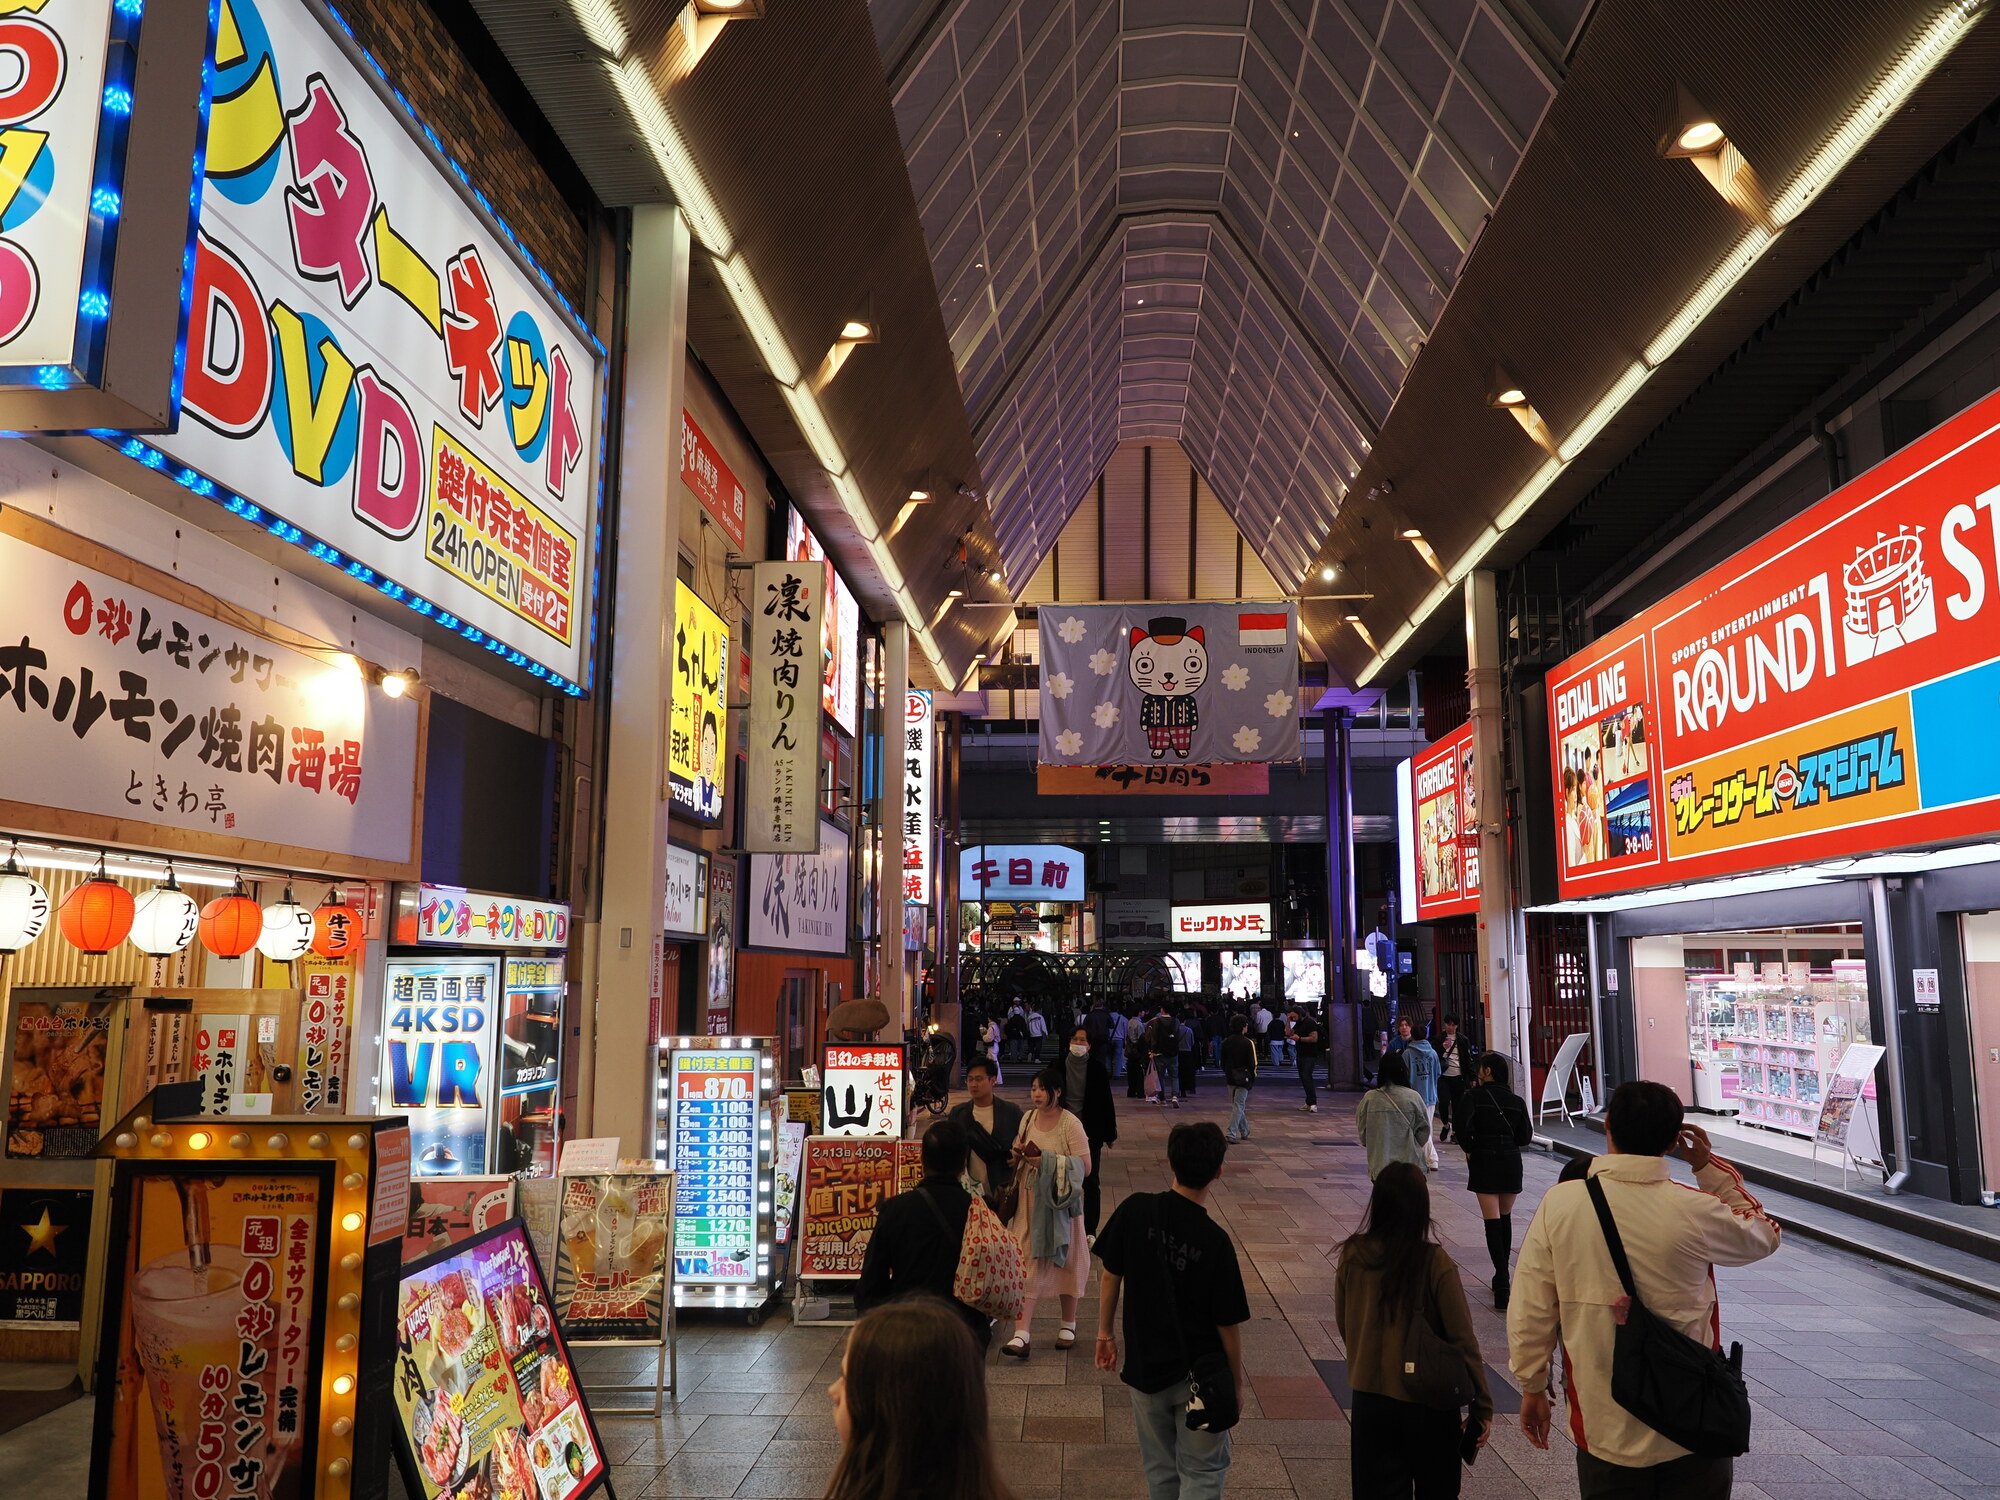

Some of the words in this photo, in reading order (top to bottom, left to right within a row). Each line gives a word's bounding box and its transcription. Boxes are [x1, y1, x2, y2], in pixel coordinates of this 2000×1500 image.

[183, 222, 426, 541] DVD
[437, 443, 572, 593] 鍵付完全個室
[1671, 636, 1709, 665] SPORTS
[1712, 584, 1806, 645] ENTERTAINMENT
[1672, 572, 1836, 737] ROUND1
[770, 628, 803, 751] 焼肉りん
[1557, 660, 1627, 732] BOWLING
[0, 635, 362, 805] ホルモン焼肉酒場
[1417, 756, 1455, 800] KARAOKE
[1799, 734, 1903, 804] スタジアム
[124, 769, 227, 824] ときわ亭
[785, 759, 794, 815] YAKINIKU
[785, 823, 793, 843] RIN
[971, 858, 1070, 889] 千日前
[22, 882, 49, 938] ハラミ
[176, 900, 198, 947] カルビ
[1180, 915, 1262, 932] ビックカメラ
[292, 912, 312, 951] ロース
[392, 974, 487, 1004] 超高画質
[391, 1005, 485, 1034] 4KSD
[327, 975, 348, 1105] 全卓サワータワー完備
[303, 1000, 327, 1114] 0秒レモン
[837, 1051, 900, 1067] 幻の手羽先
[387, 1039, 483, 1109] VR
[704, 1077, 752, 1099] 870円
[711, 1101, 752, 1114] 1,100円
[874, 1072, 896, 1130] 世界の
[707, 1131, 752, 1143] 3,400円
[708, 1116, 752, 1129] 2,100円
[707, 1145, 752, 1158] 4,250円
[707, 1160, 752, 1172] 2,540円
[812, 1147, 852, 1158] 2月13日
[707, 1175, 751, 1187] 2,240円
[810, 1160, 894, 1183] コース料金
[706, 1205, 750, 1217] 3,400円
[707, 1190, 751, 1202] 2,540円
[248, 1221, 275, 1251] 元祖
[406, 1216, 470, 1238] 日本一
[708, 1219, 750, 1232] 1,270円
[675, 1257, 709, 1274] VR
[575, 1271, 643, 1291] スーパー
[277, 1218, 309, 1433] 全卓サワータワー完備
[228, 1260, 273, 1500] 0秒レモンサ
